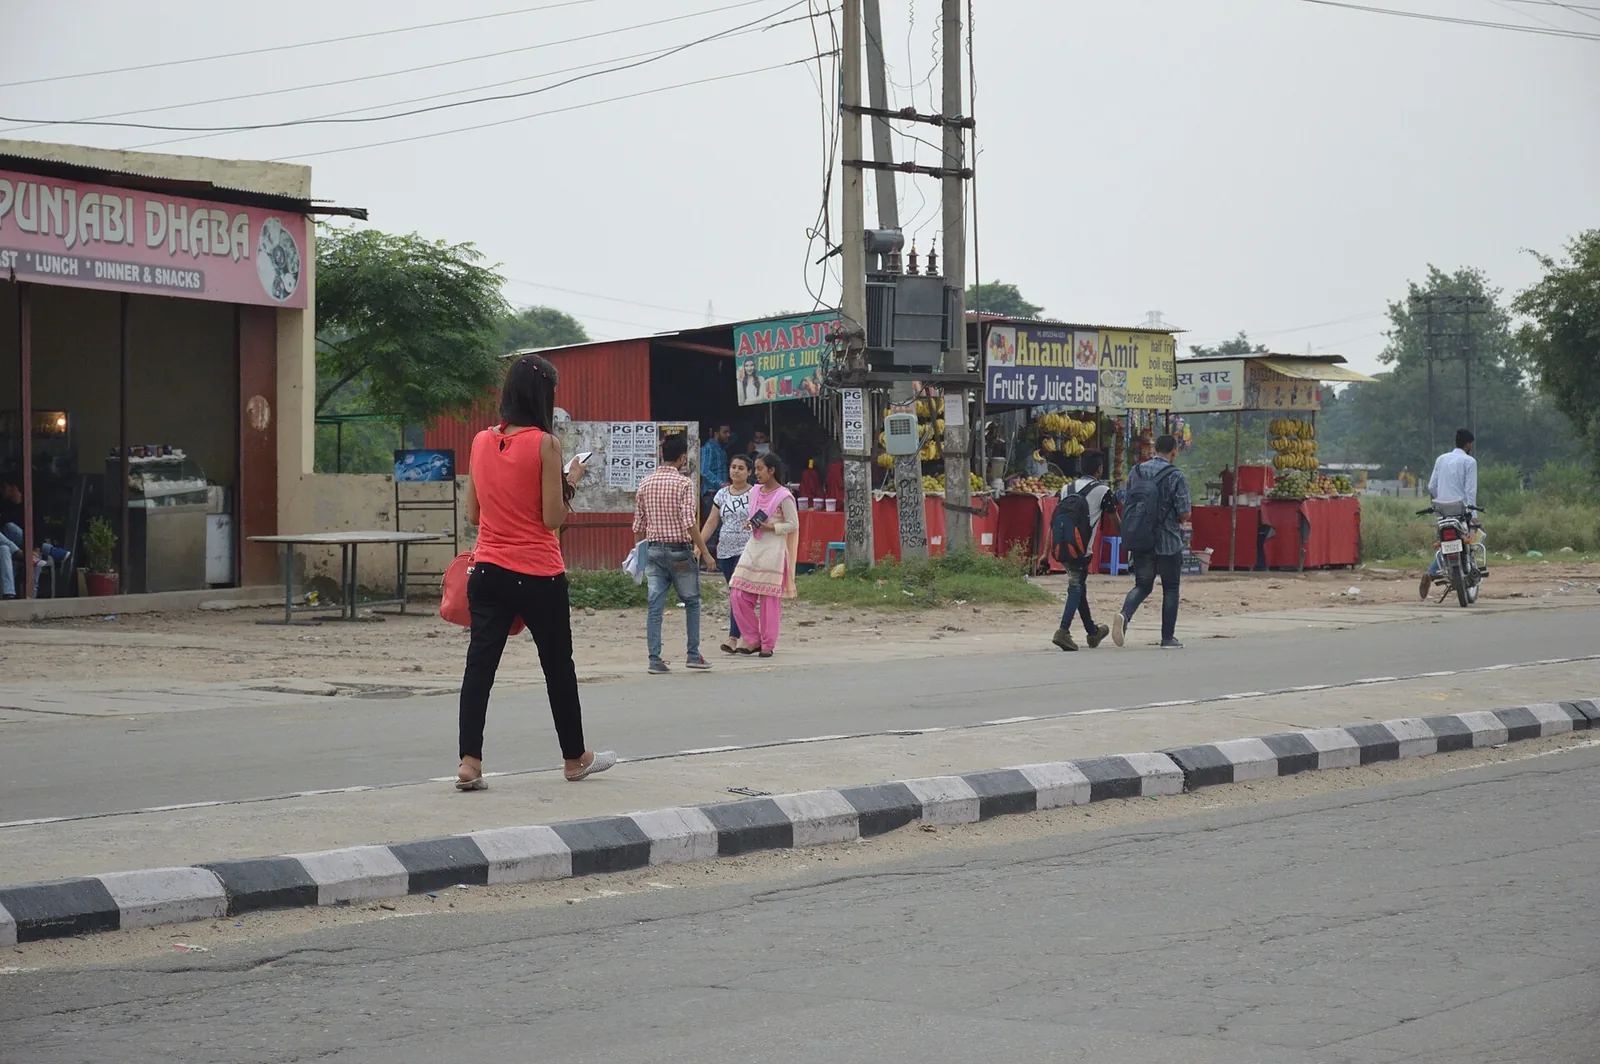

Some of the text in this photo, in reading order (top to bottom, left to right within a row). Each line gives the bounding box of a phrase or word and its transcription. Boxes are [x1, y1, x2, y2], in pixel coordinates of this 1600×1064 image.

[0, 179, 250, 263] PUNJABI DHABA
[35, 252, 79, 276] LUNCH
[95, 261, 140, 282] DINNER
[143, 270, 152, 283] &
[155, 270, 200, 288] SNACKS
[736, 320, 844, 357] AMARJI
[1015, 331, 1074, 368] Anand
[1100, 334, 1139, 369] Amit
[1150, 339, 1173, 356] half fry
[758, 353, 785, 371] FRUIT
[789, 352, 796, 367] &
[800, 348, 823, 366] JUIC
[1148, 356, 1173, 373] boil egg
[1142, 376, 1153, 389] egg
[1199, 371, 1230, 384] बार
[844, 391, 861, 399] PG
[993, 373, 1097, 402] Fruit & Juice Bar
[1127, 389, 1172, 405] bread omelette
[612, 425, 632, 434] PG
[635, 425, 655, 434] PG
[845, 421, 862, 429] PG
[611, 458, 631, 466] PG
[635, 460, 655, 469] PG
[848, 504, 865, 518] BOY
